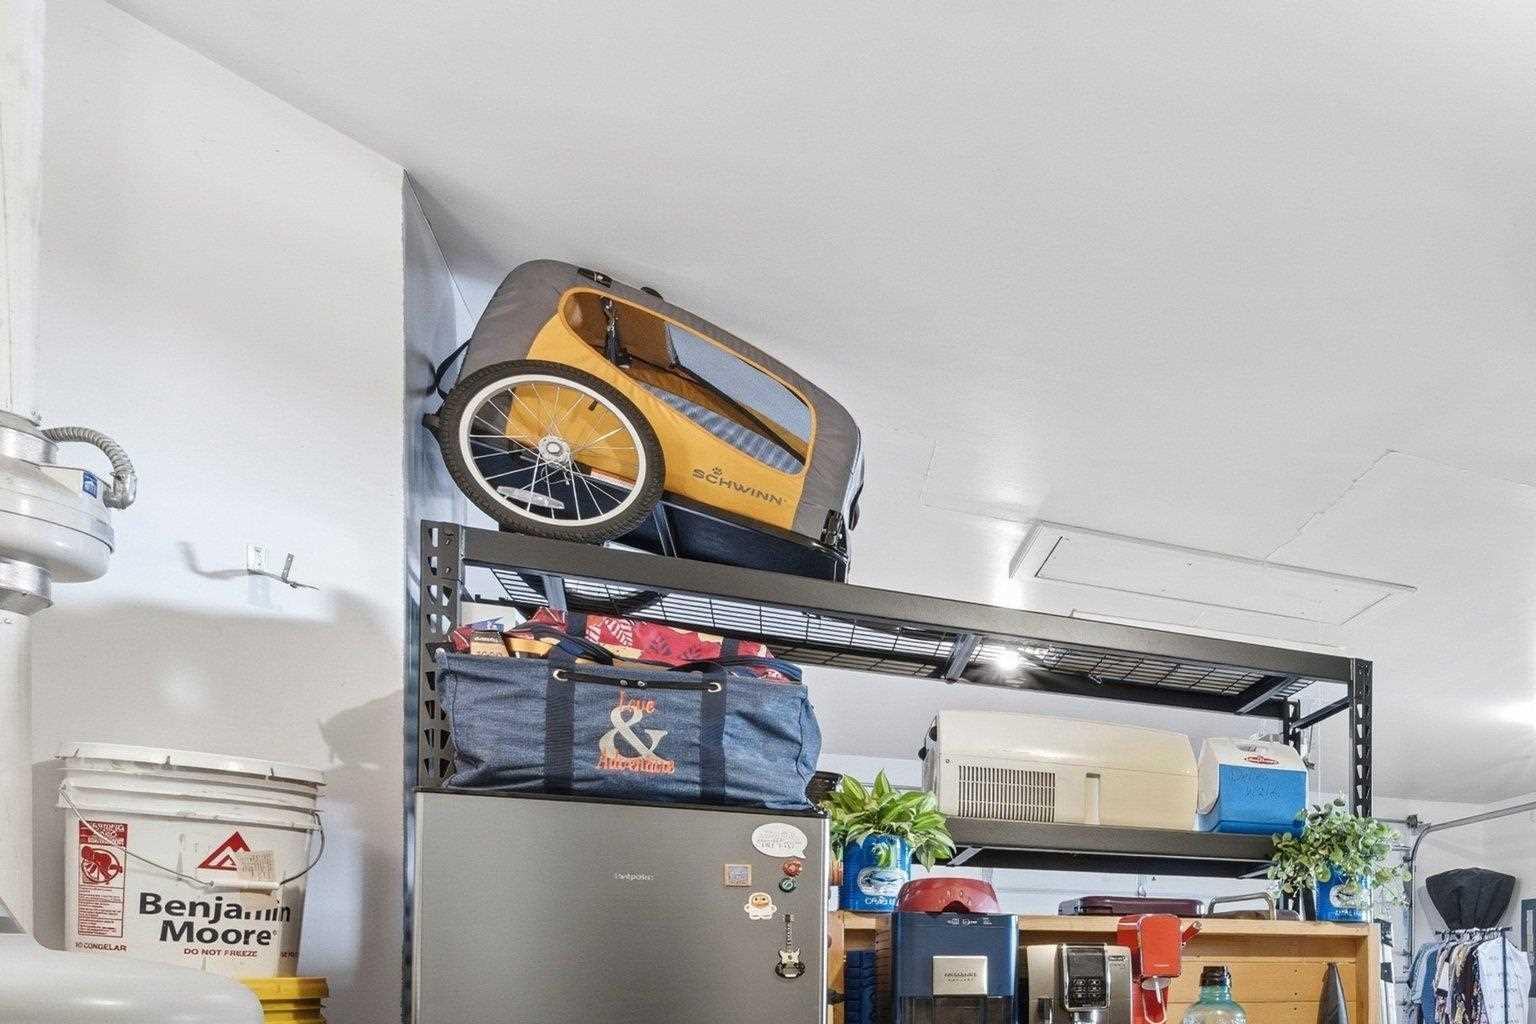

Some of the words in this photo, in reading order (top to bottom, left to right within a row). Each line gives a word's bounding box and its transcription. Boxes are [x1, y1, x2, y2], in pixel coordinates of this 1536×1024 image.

[692, 468, 784, 506] SCHWINN
[159, 919, 273, 946] Moore
[184, 948, 200, 956] DO
[201, 949, 222, 957] NOT
[223, 950, 258, 959] FREEZE
